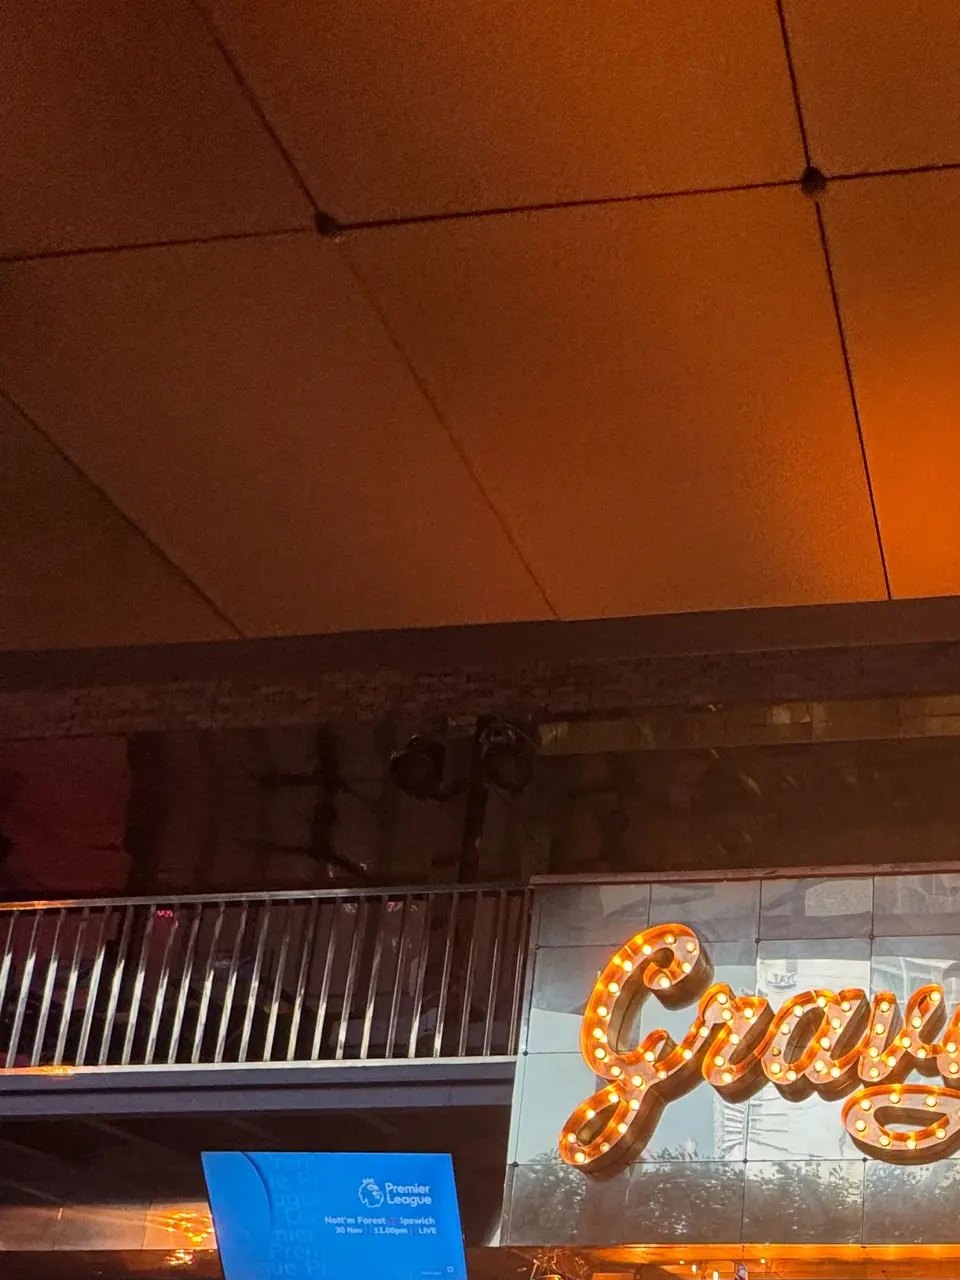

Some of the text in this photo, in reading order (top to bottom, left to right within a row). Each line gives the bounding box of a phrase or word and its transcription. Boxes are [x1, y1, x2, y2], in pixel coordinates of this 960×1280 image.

[384, 1182, 431, 1194] Premier
[386, 1193, 432, 1207] League
[357, 1216, 387, 1225] Forest
[400, 1216, 436, 1227] Ipswich
[418, 1226, 437, 1235] LIVE
